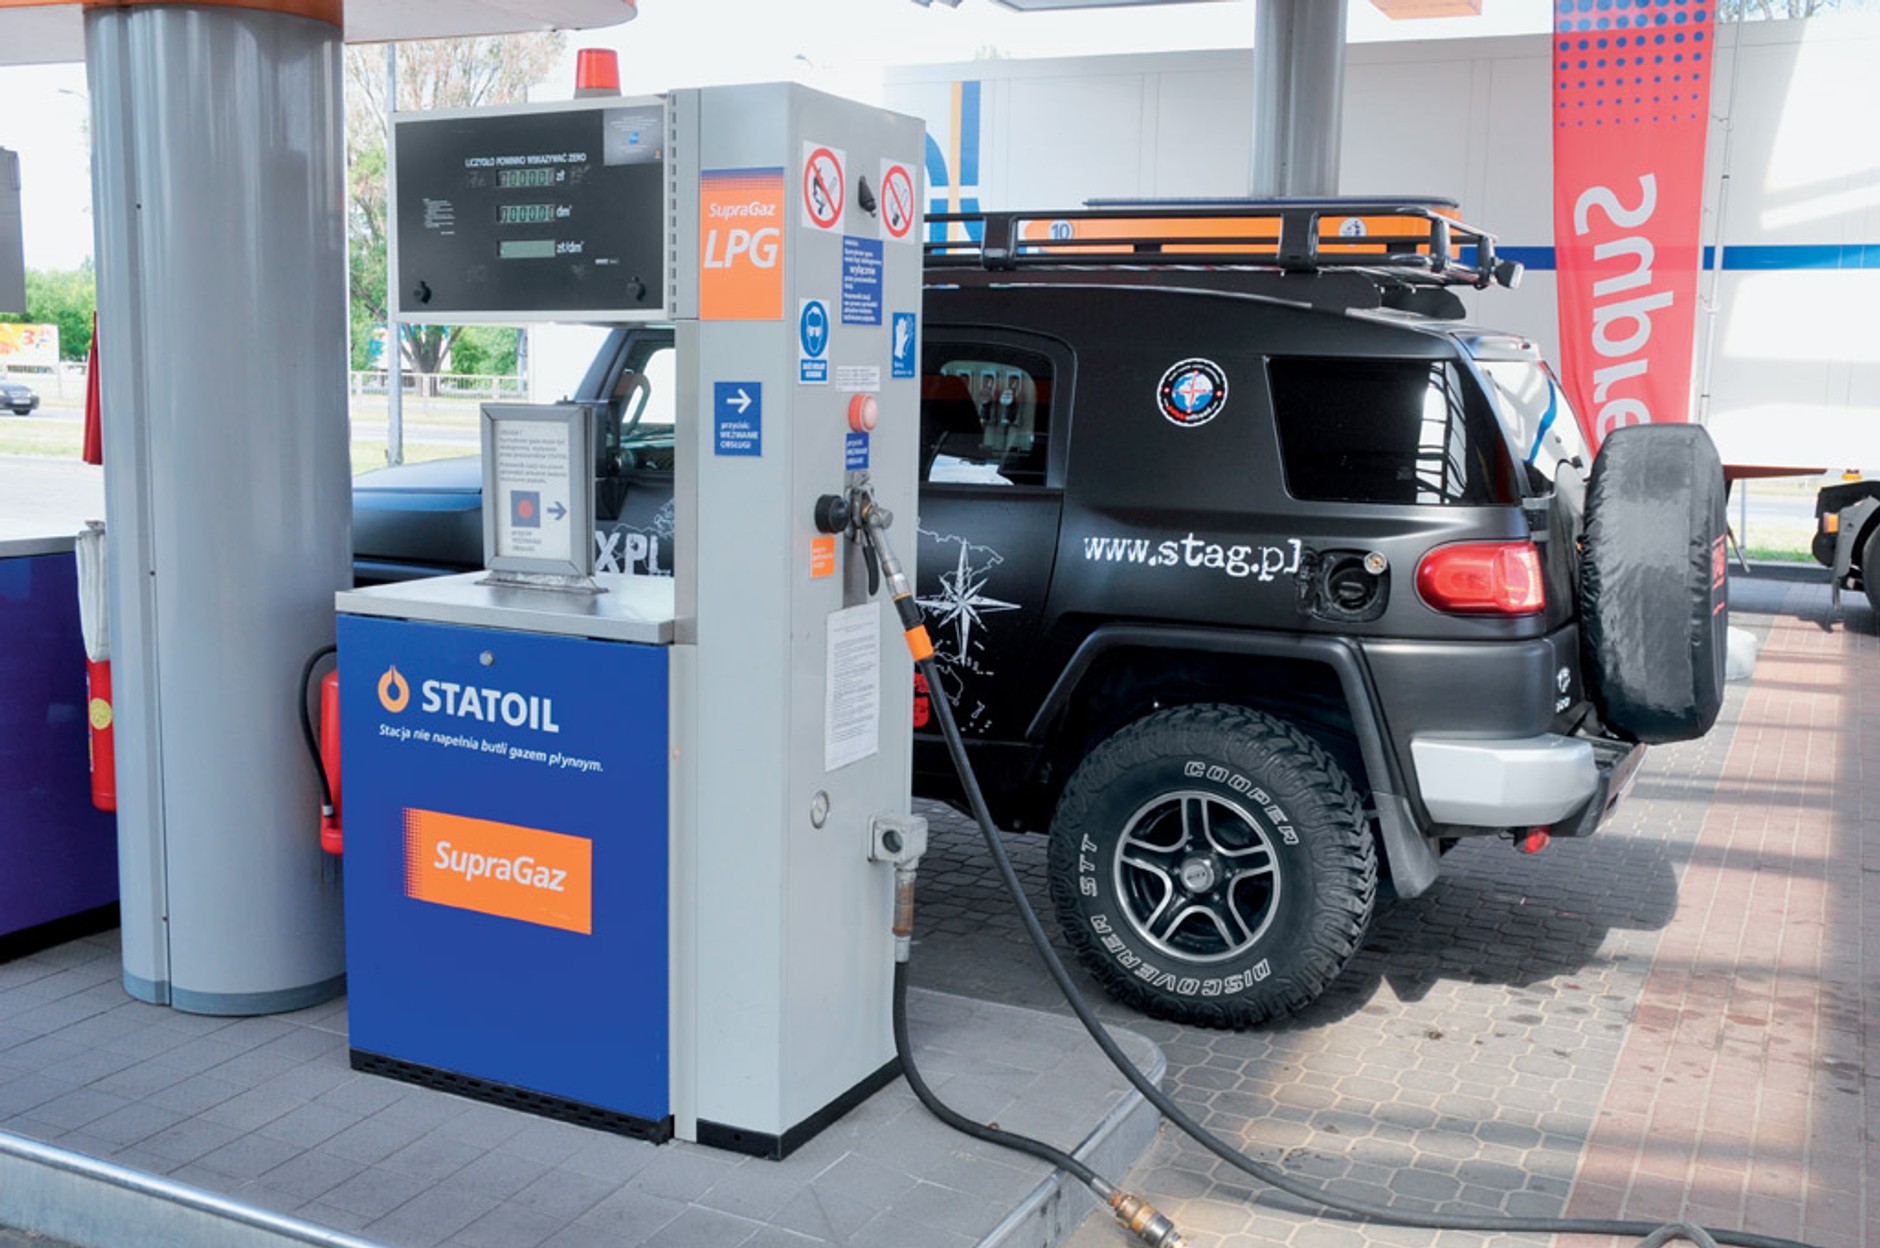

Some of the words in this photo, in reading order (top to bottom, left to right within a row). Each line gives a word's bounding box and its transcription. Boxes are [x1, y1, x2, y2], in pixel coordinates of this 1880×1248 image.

[709, 202, 776, 221] SupraGaz
[1051, 223, 1070, 240] 10
[703, 227, 780, 269] LPG
[1083, 532, 1302, 581] www.stag.pl
[422, 679, 560, 733] STATOIL
[379, 723, 411, 741] Stacja
[413, 730, 431, 741] nie
[481, 739, 508, 755] butli
[509, 747, 547, 762] gazem
[1184, 761, 1299, 846] COOPER
[434, 841, 567, 892] SupraGaz
[1079, 833, 1098, 897] STT
[1090, 914, 1272, 996] DISCOVERER
